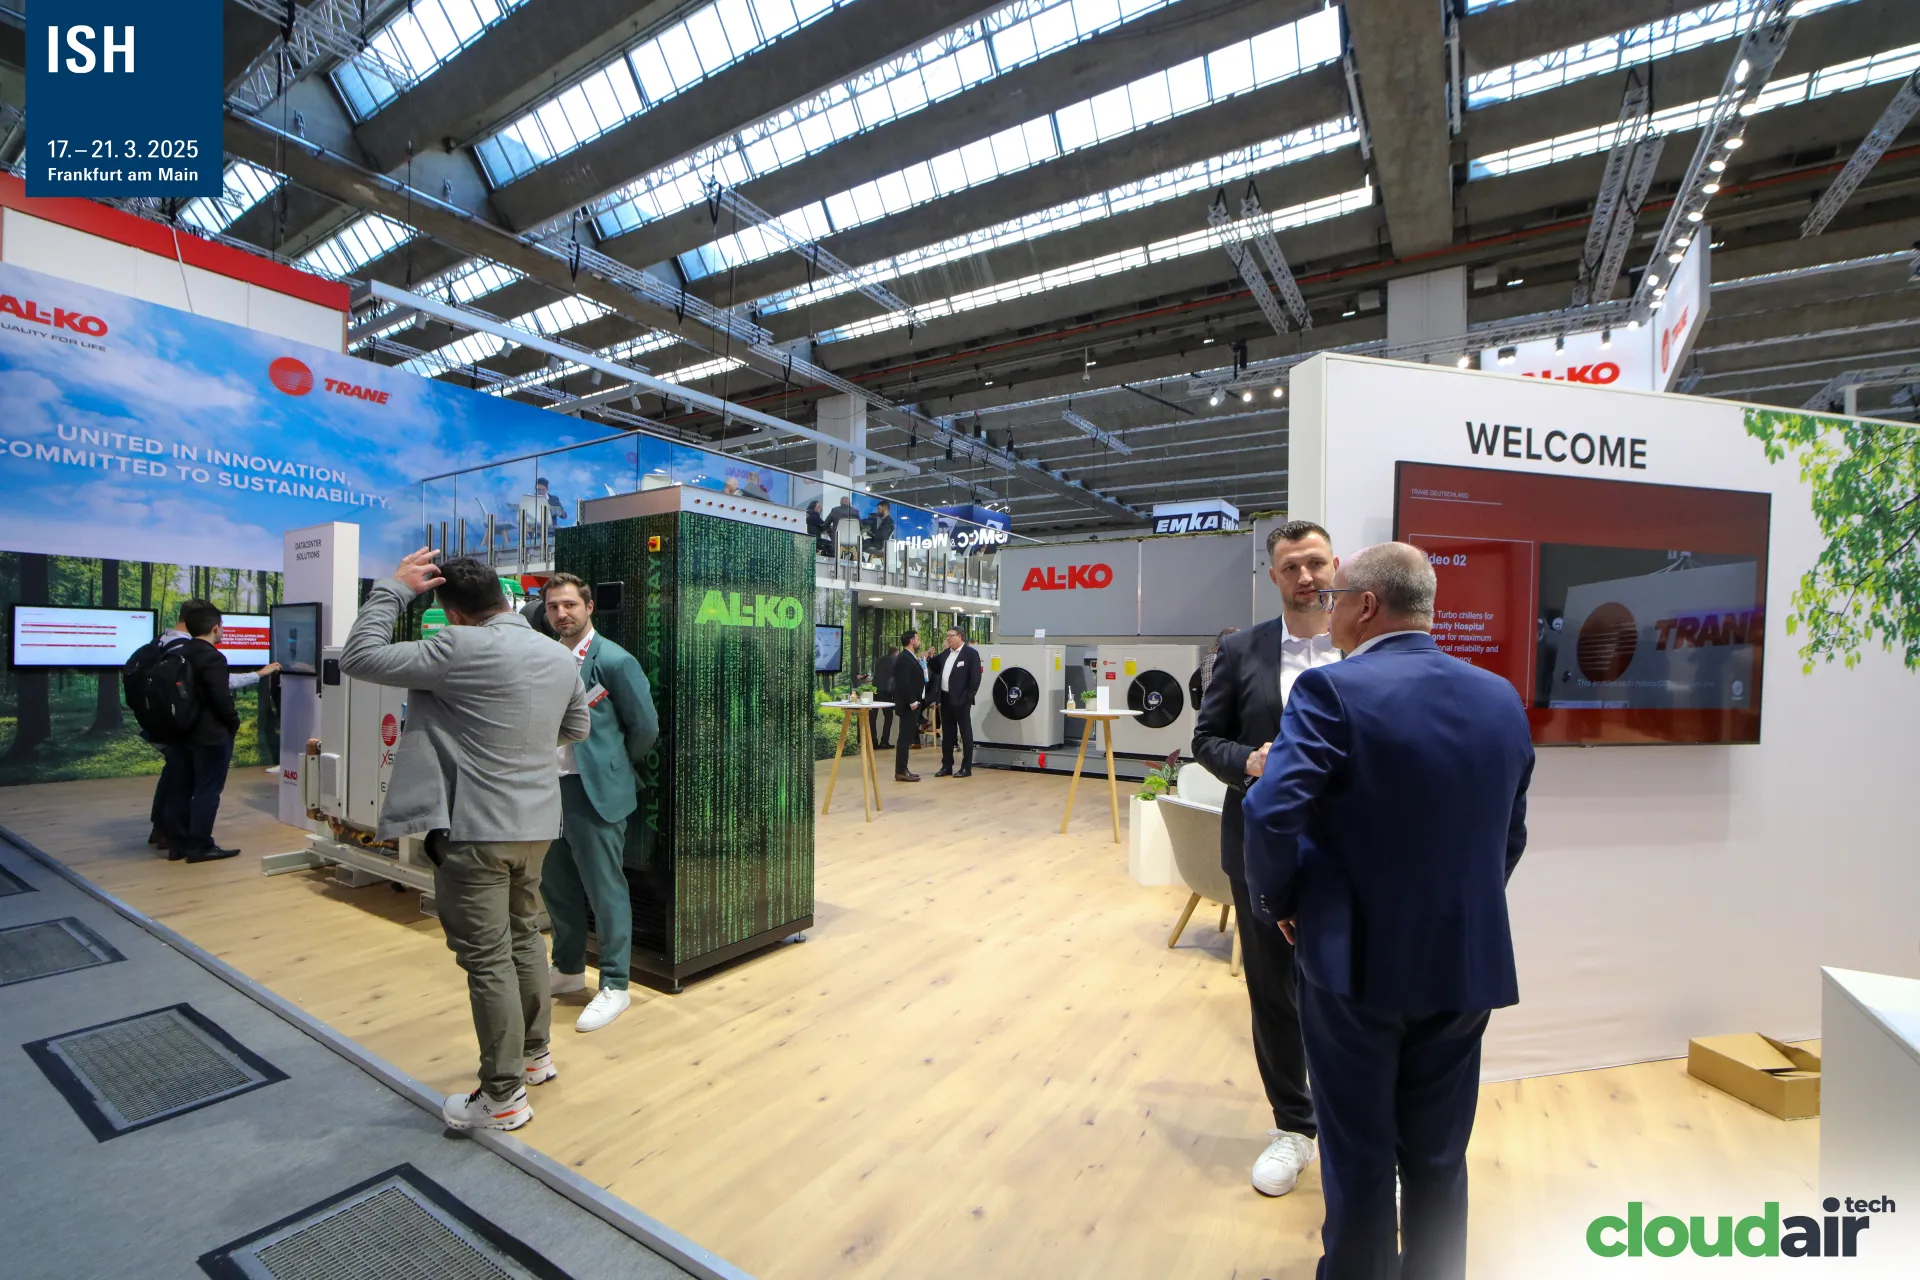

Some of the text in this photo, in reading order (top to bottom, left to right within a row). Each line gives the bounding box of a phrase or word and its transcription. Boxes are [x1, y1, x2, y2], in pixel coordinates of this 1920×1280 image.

[0, 294, 108, 337] AL-KO
[1, 322, 107, 352] UALITY FOR LIFE
[324, 377, 389, 405] TRANE
[58, 423, 352, 486] UNITED IN INNOVATION,
[1465, 421, 1647, 470] WELCOME
[176, 465, 210, 484] TO
[218, 471, 392, 510] SUSTAINABILITY.
[1429, 489, 1469, 499] DEUTSCHLAND
[1453, 554, 1467, 567] 02
[1021, 563, 1113, 591] AL-KO
[694, 589, 804, 629] AL-KO
[1437, 610, 1458, 619] Turbo
[1459, 612, 1483, 620] chillers
[1484, 612, 1494, 620] for
[1432, 622, 1485, 632] ersity Hospital
[1447, 633, 1457, 641] for
[1458, 634, 1492, 642] maximum
[1454, 644, 1484, 654] reliability
[1486, 645, 1499, 653] and
